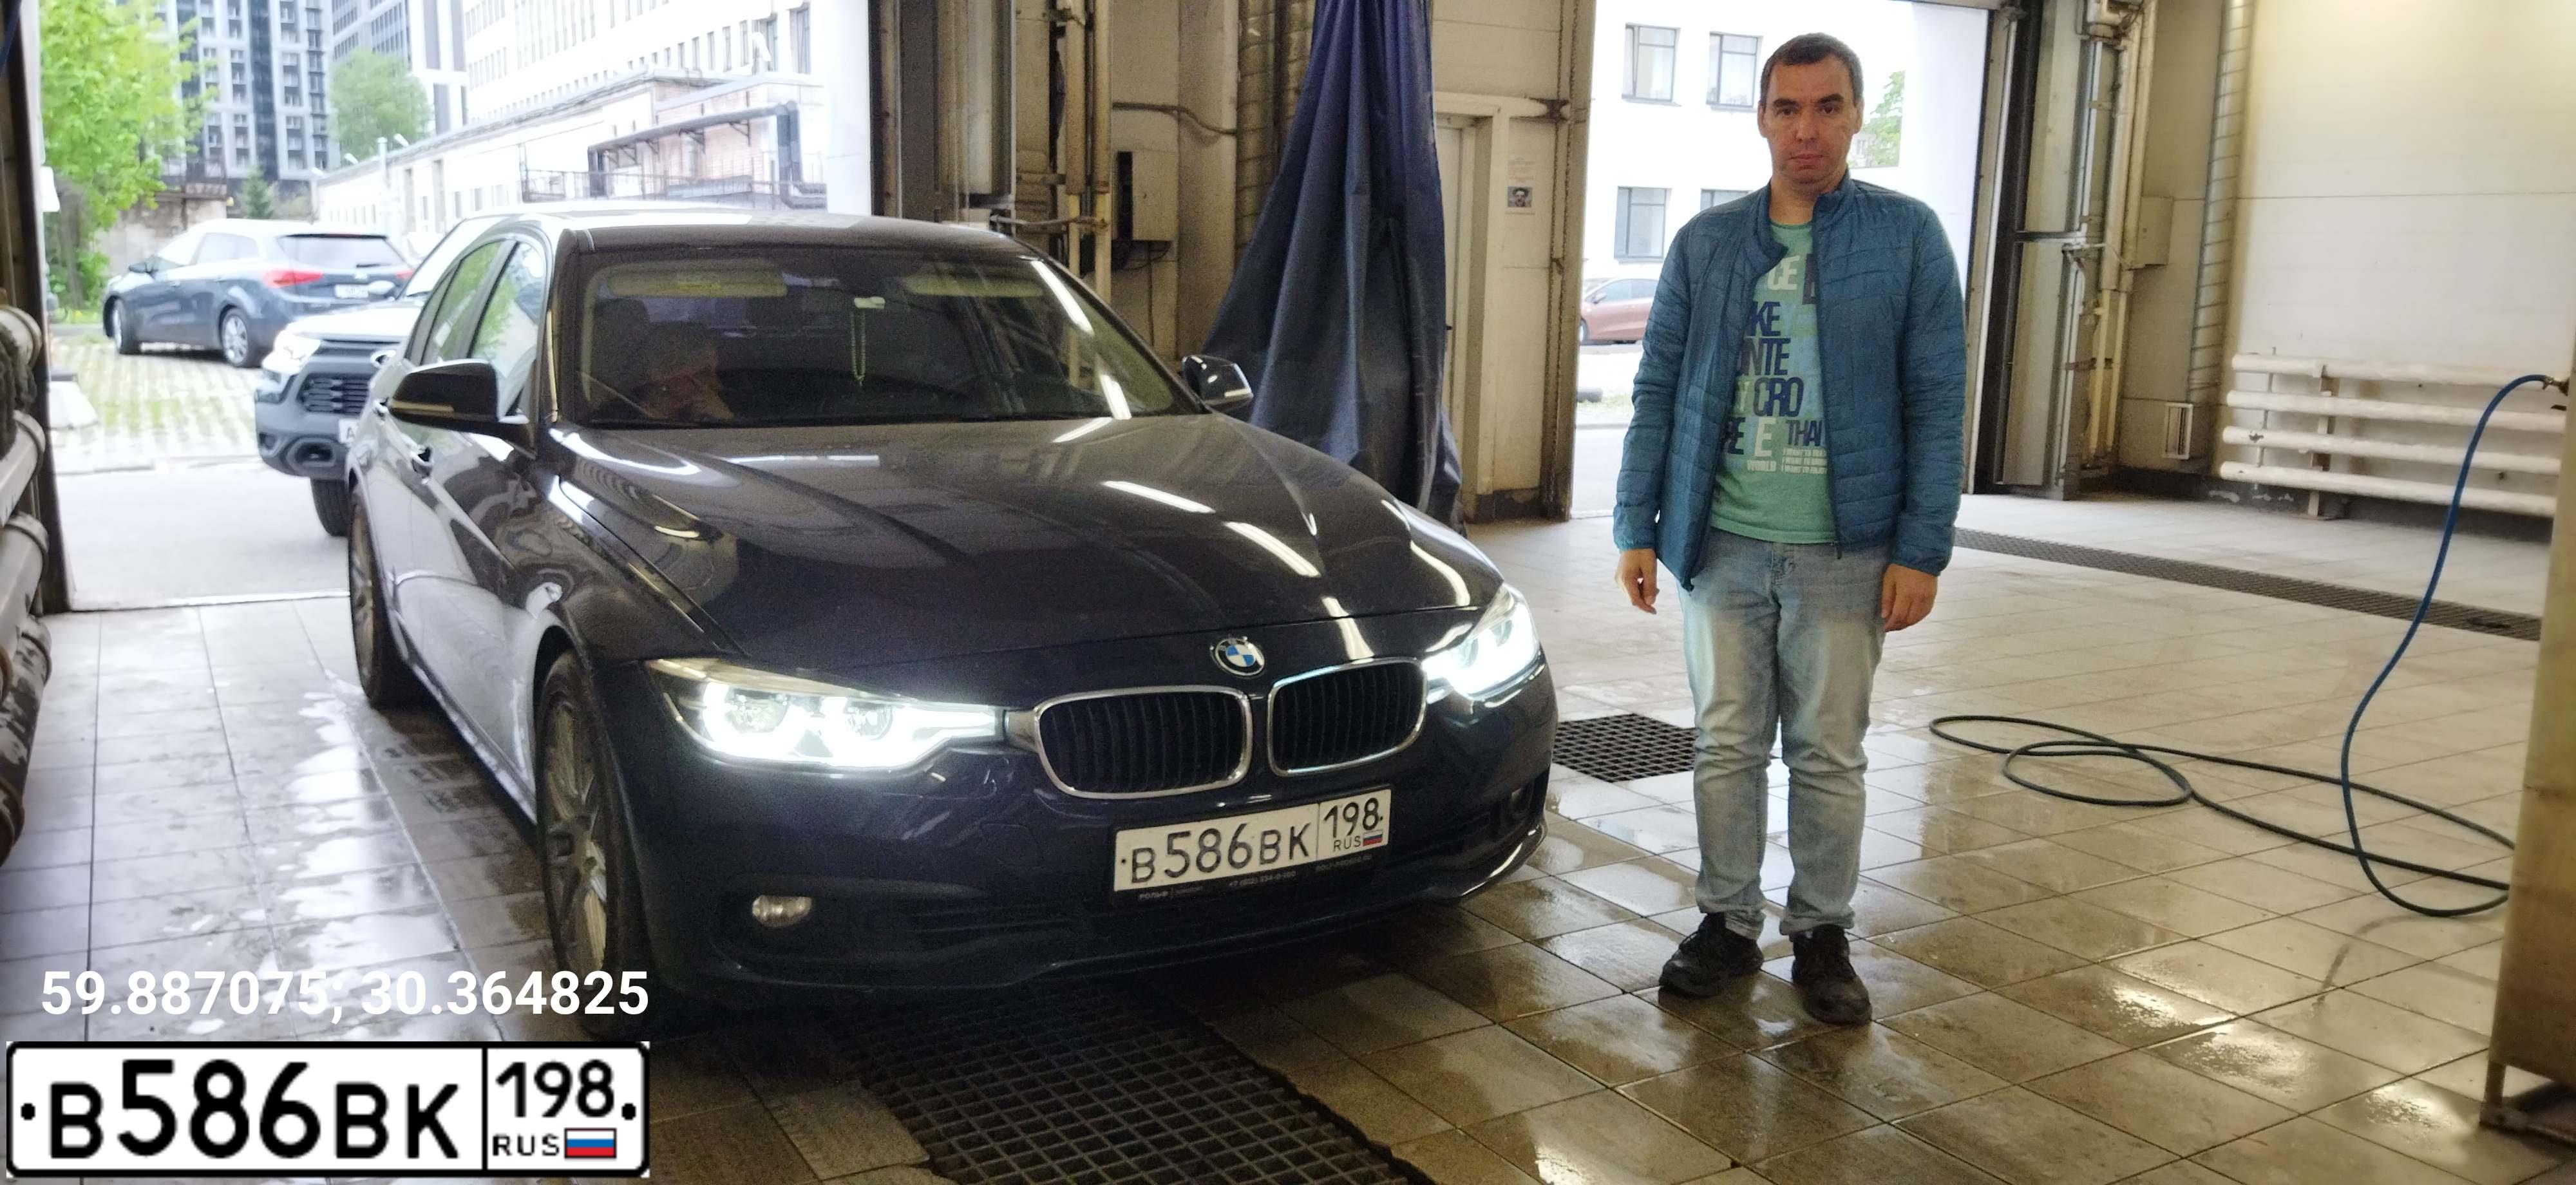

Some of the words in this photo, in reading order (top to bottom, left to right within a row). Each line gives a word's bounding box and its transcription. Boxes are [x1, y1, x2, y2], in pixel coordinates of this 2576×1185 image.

[1131, 821, 1312, 883] В586ВК
[1323, 797, 1379, 837] 198
[1333, 838, 1362, 853] RUS
